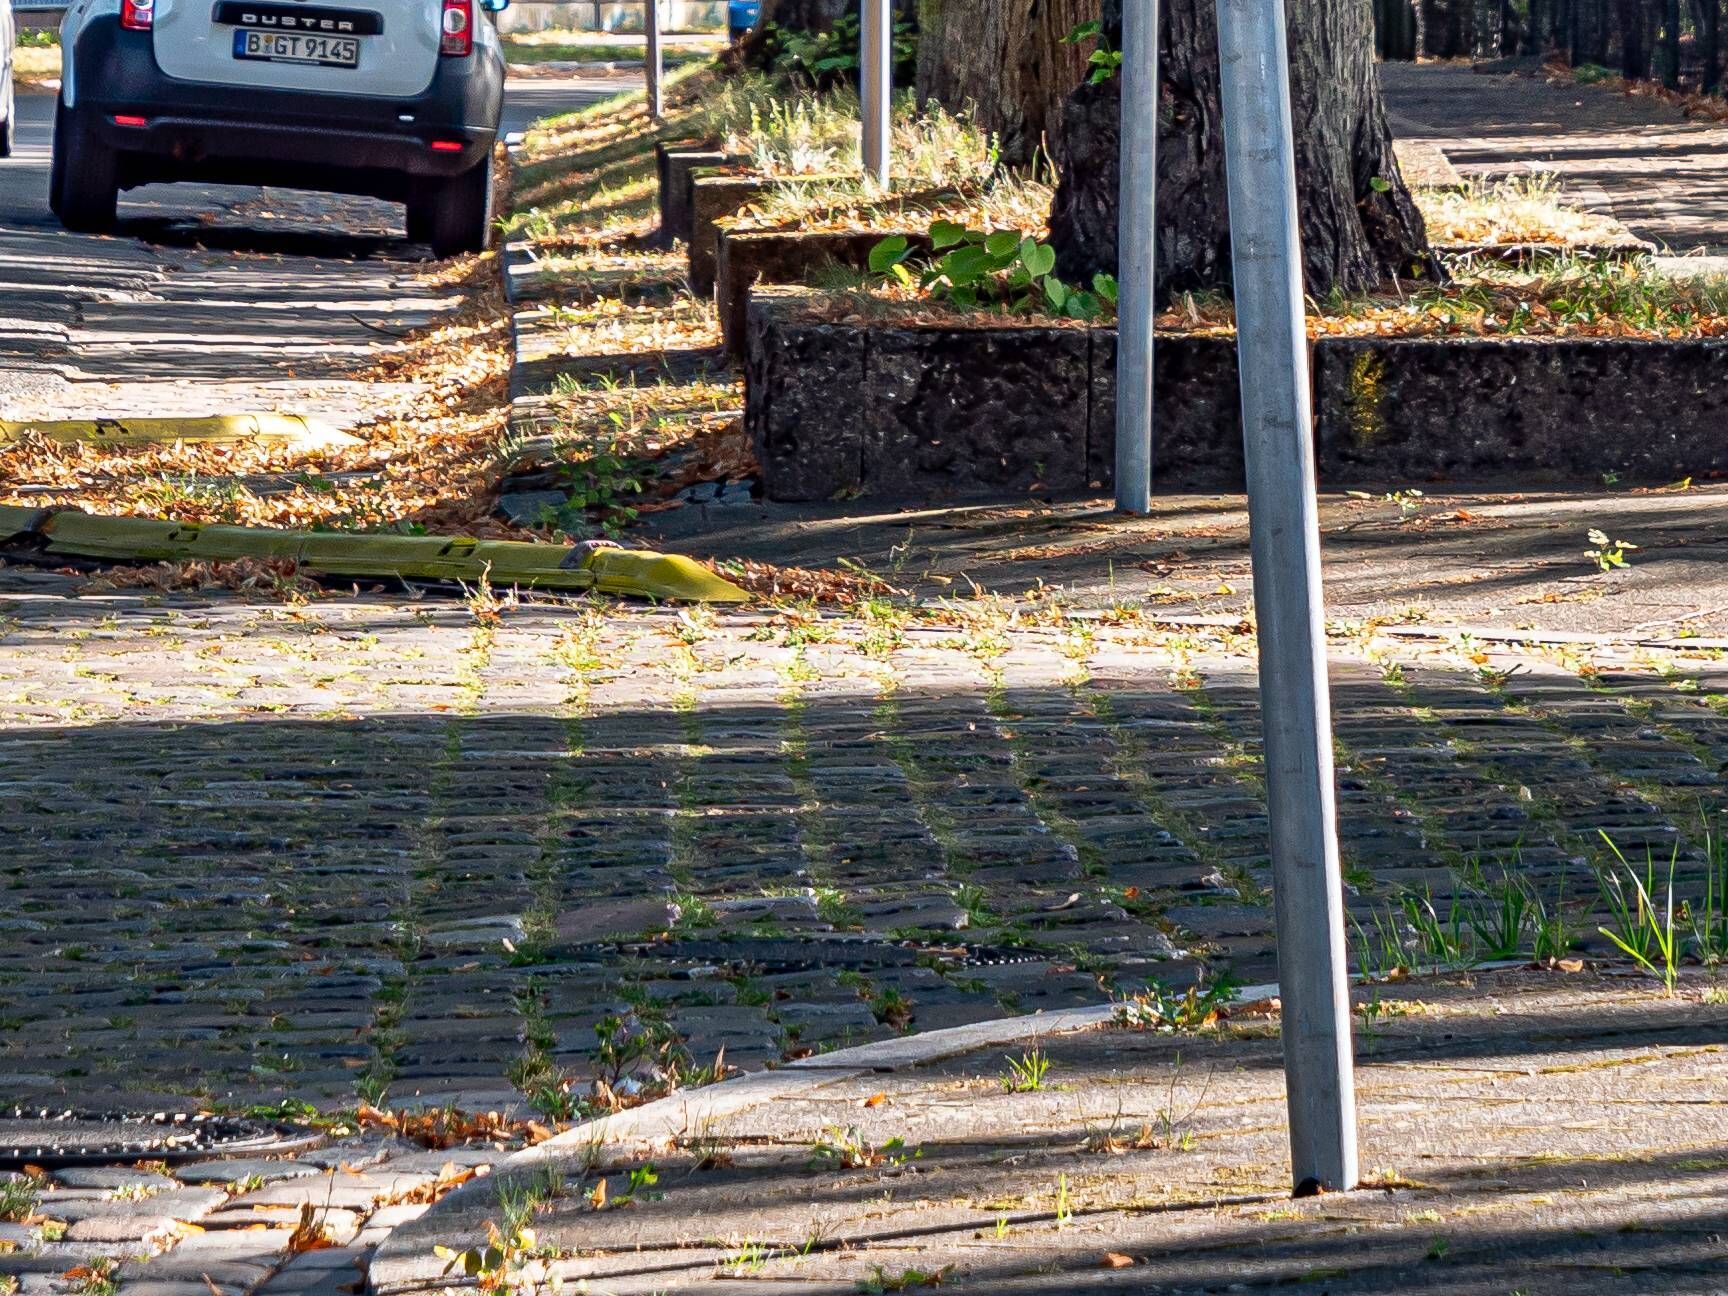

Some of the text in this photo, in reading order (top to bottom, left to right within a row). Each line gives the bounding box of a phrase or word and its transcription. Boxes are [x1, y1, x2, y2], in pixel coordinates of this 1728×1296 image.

[241, 13, 354, 31] DUSTER
[248, 34, 261, 53] B
[306, 39, 354, 60] 9145
